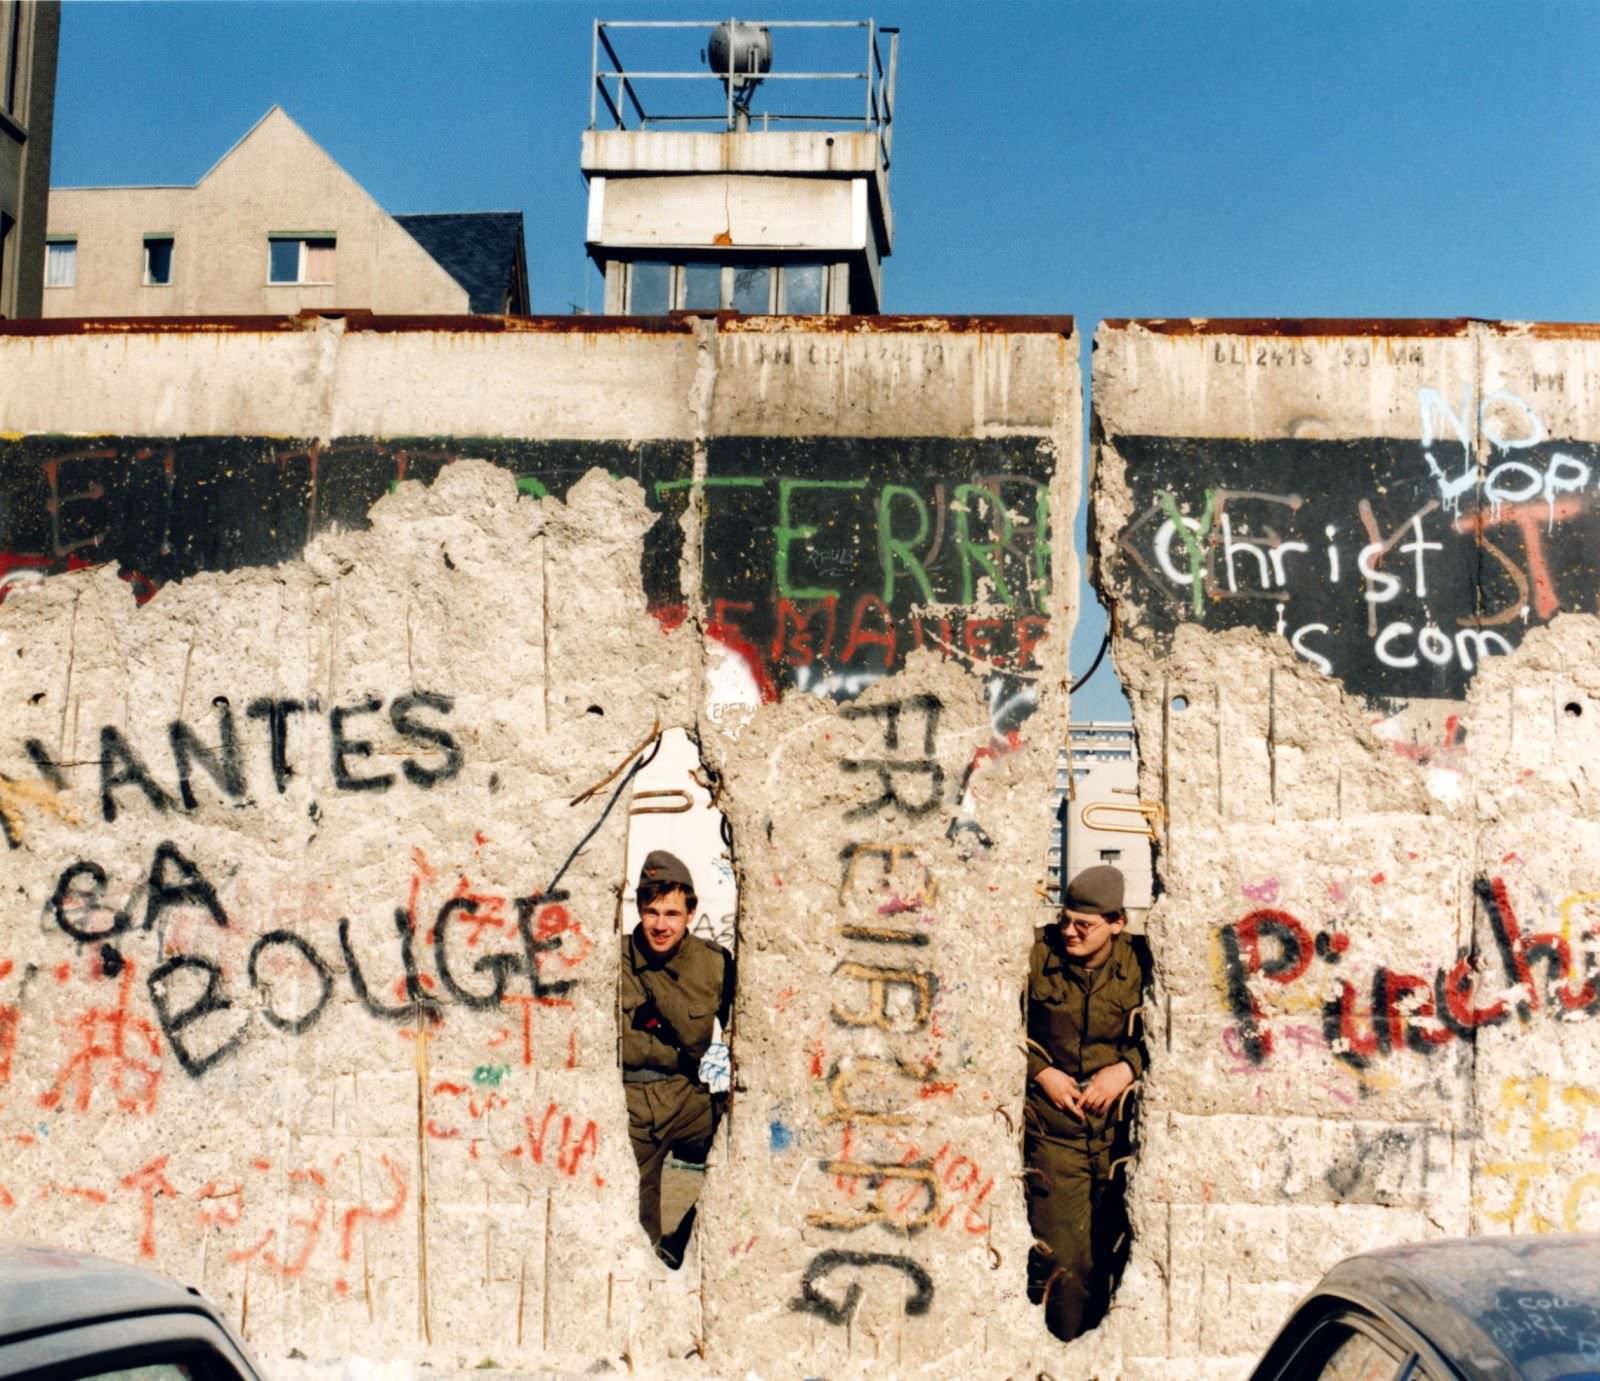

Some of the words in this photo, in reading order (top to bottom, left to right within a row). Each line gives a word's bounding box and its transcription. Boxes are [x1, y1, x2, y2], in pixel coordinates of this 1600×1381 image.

[1417, 382, 1546, 450] NO
[1154, 511, 1443, 603] Christ
[147, 889, 577, 1079] BOUGE
